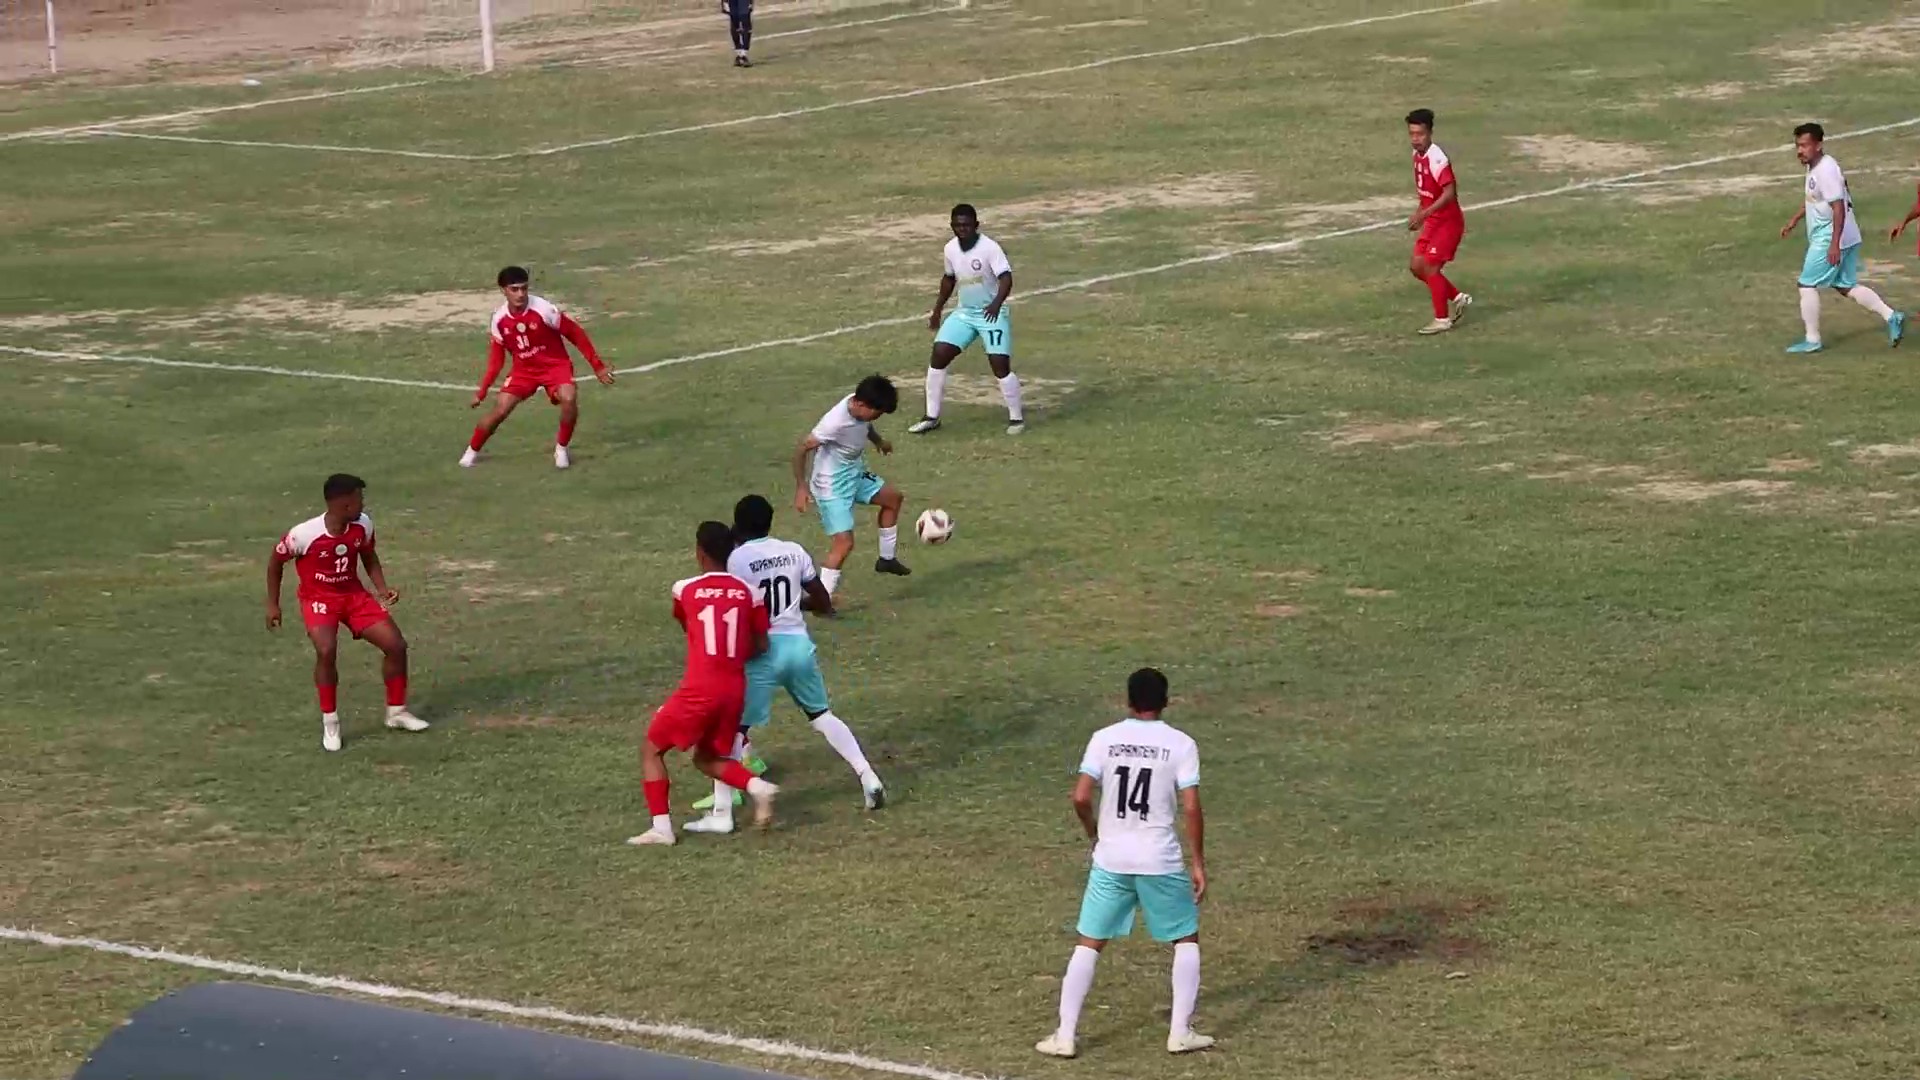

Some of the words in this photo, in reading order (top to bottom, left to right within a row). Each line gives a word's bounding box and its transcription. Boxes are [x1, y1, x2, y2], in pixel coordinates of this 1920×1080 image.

[988, 329, 1003, 346] 17
[334, 557, 349, 573] 12
[694, 588, 723, 600] APF
[727, 589, 746, 600] FC
[758, 575, 792, 619] 10
[311, 602, 327, 614] 12
[697, 604, 740, 658] 11
[1114, 765, 1153, 822] 14
